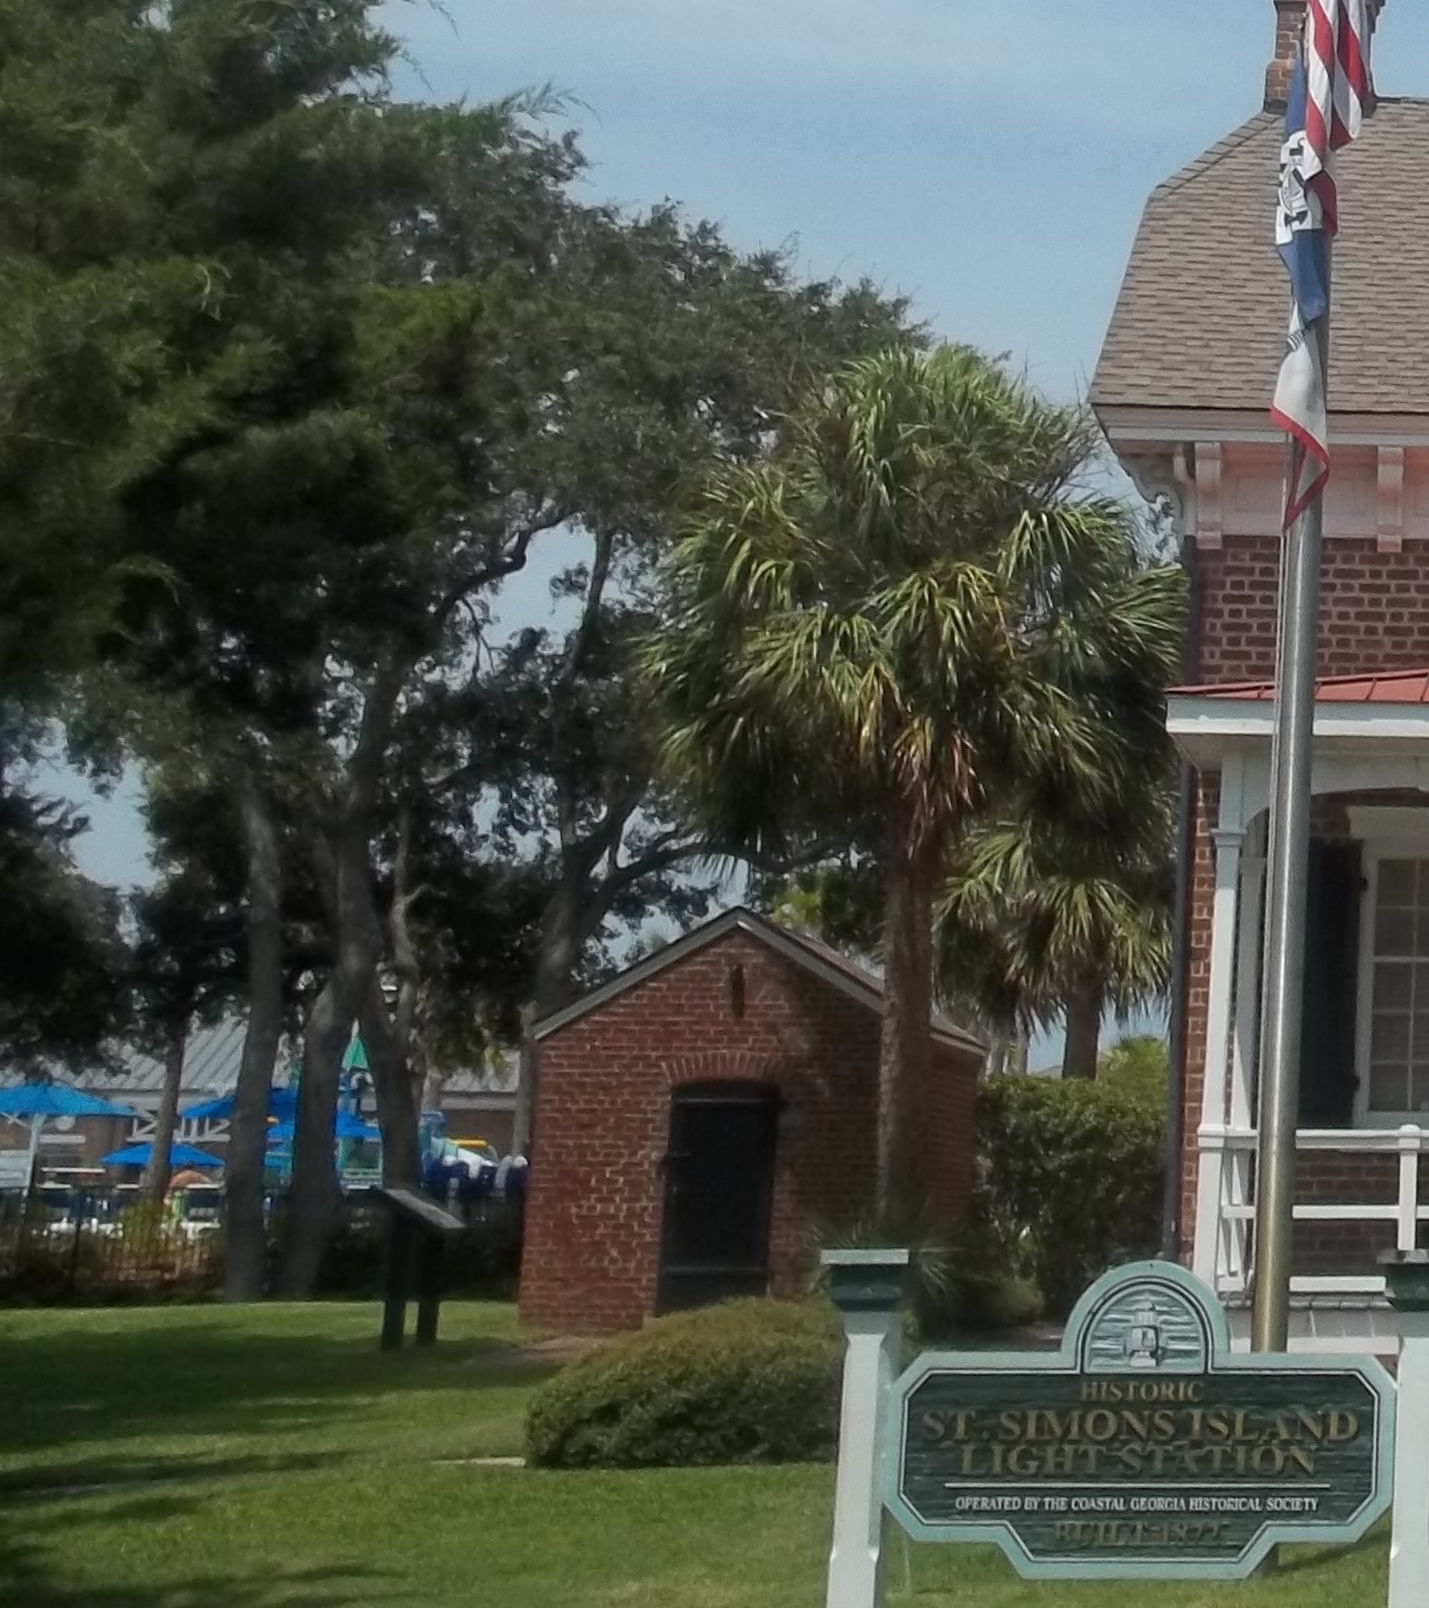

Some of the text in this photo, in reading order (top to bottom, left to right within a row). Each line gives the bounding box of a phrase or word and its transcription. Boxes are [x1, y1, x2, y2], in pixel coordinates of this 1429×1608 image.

[1080, 1380, 1204, 1402] HISTORIC
[996, 1408, 1175, 1441] SIMONS
[1188, 1408, 1358, 1441] ISLAND
[960, 1443, 1317, 1476] LIGHT STATION
[955, 1496, 1319, 1511] OPERATED BY THE COASTAL GEORGIA HISTORICAL SOCIETY
